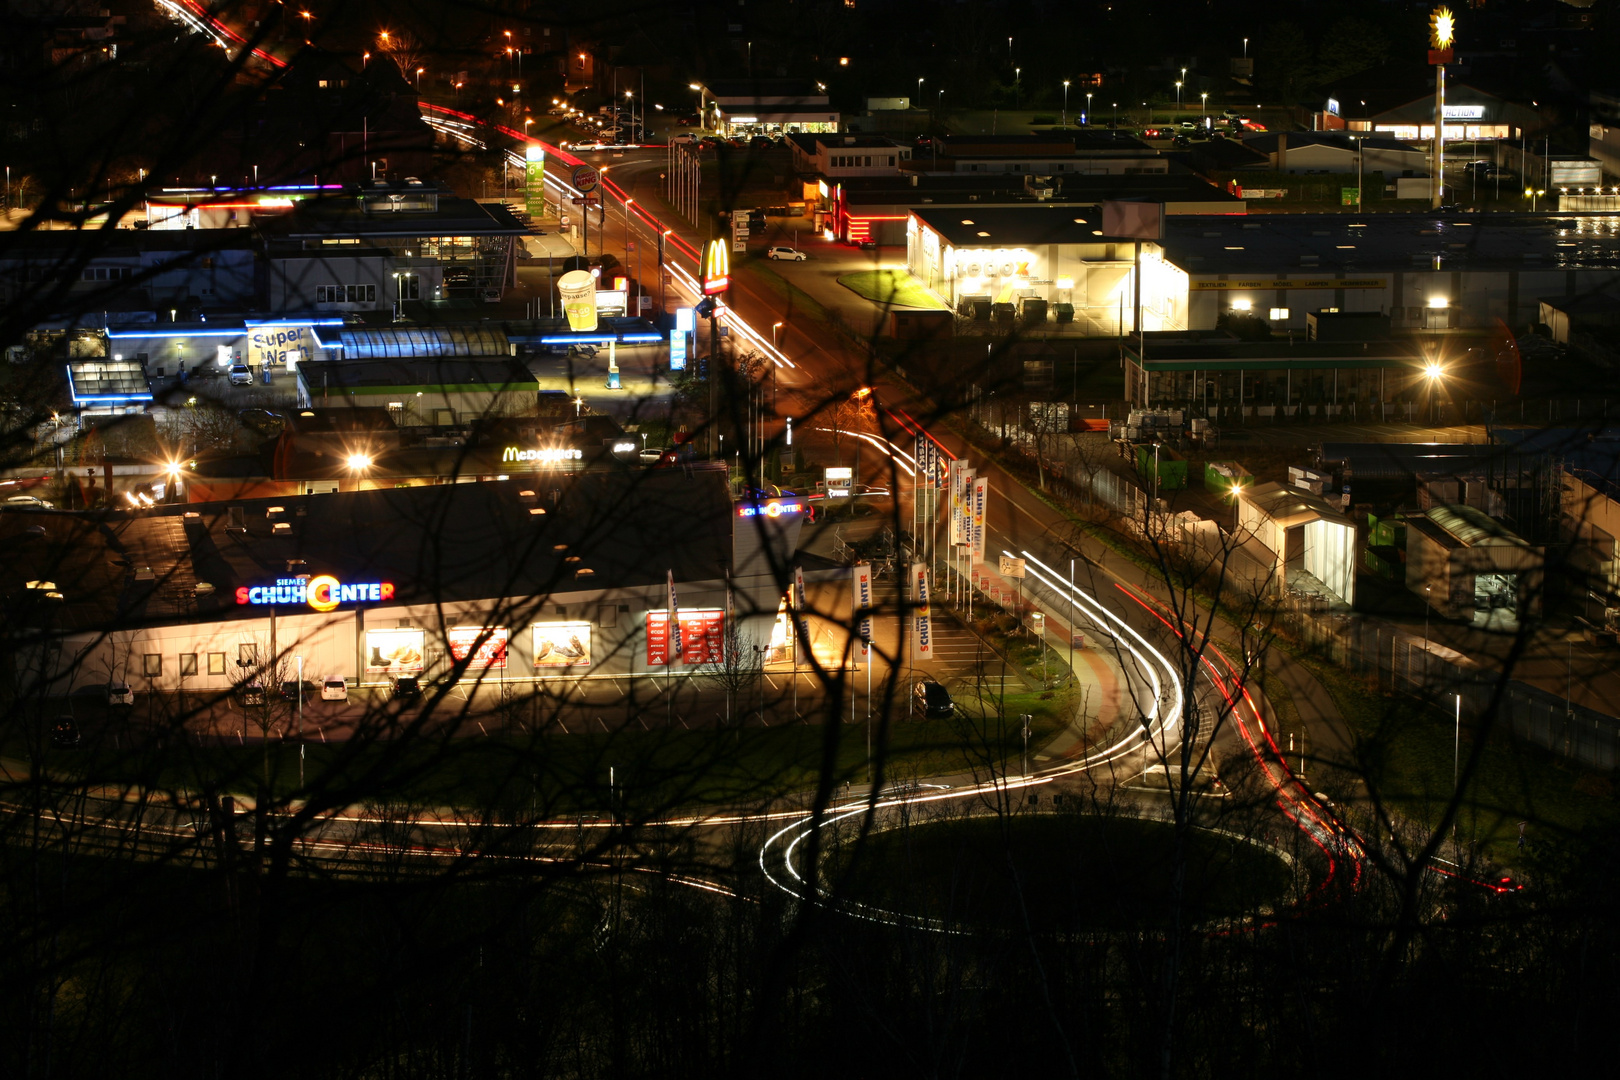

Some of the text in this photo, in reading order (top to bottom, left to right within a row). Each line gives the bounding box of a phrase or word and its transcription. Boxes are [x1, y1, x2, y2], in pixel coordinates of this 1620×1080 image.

[576, 176, 597, 187] KING
[957, 259, 1029, 278] tedox
[253, 328, 303, 348] Super
[262, 344, 309, 365] Wah
[503, 446, 582, 462] McDold's
[236, 586, 306, 604] SCHUH
[918, 571, 928, 612] CENTER
[920, 616, 928, 652] SCHUH
